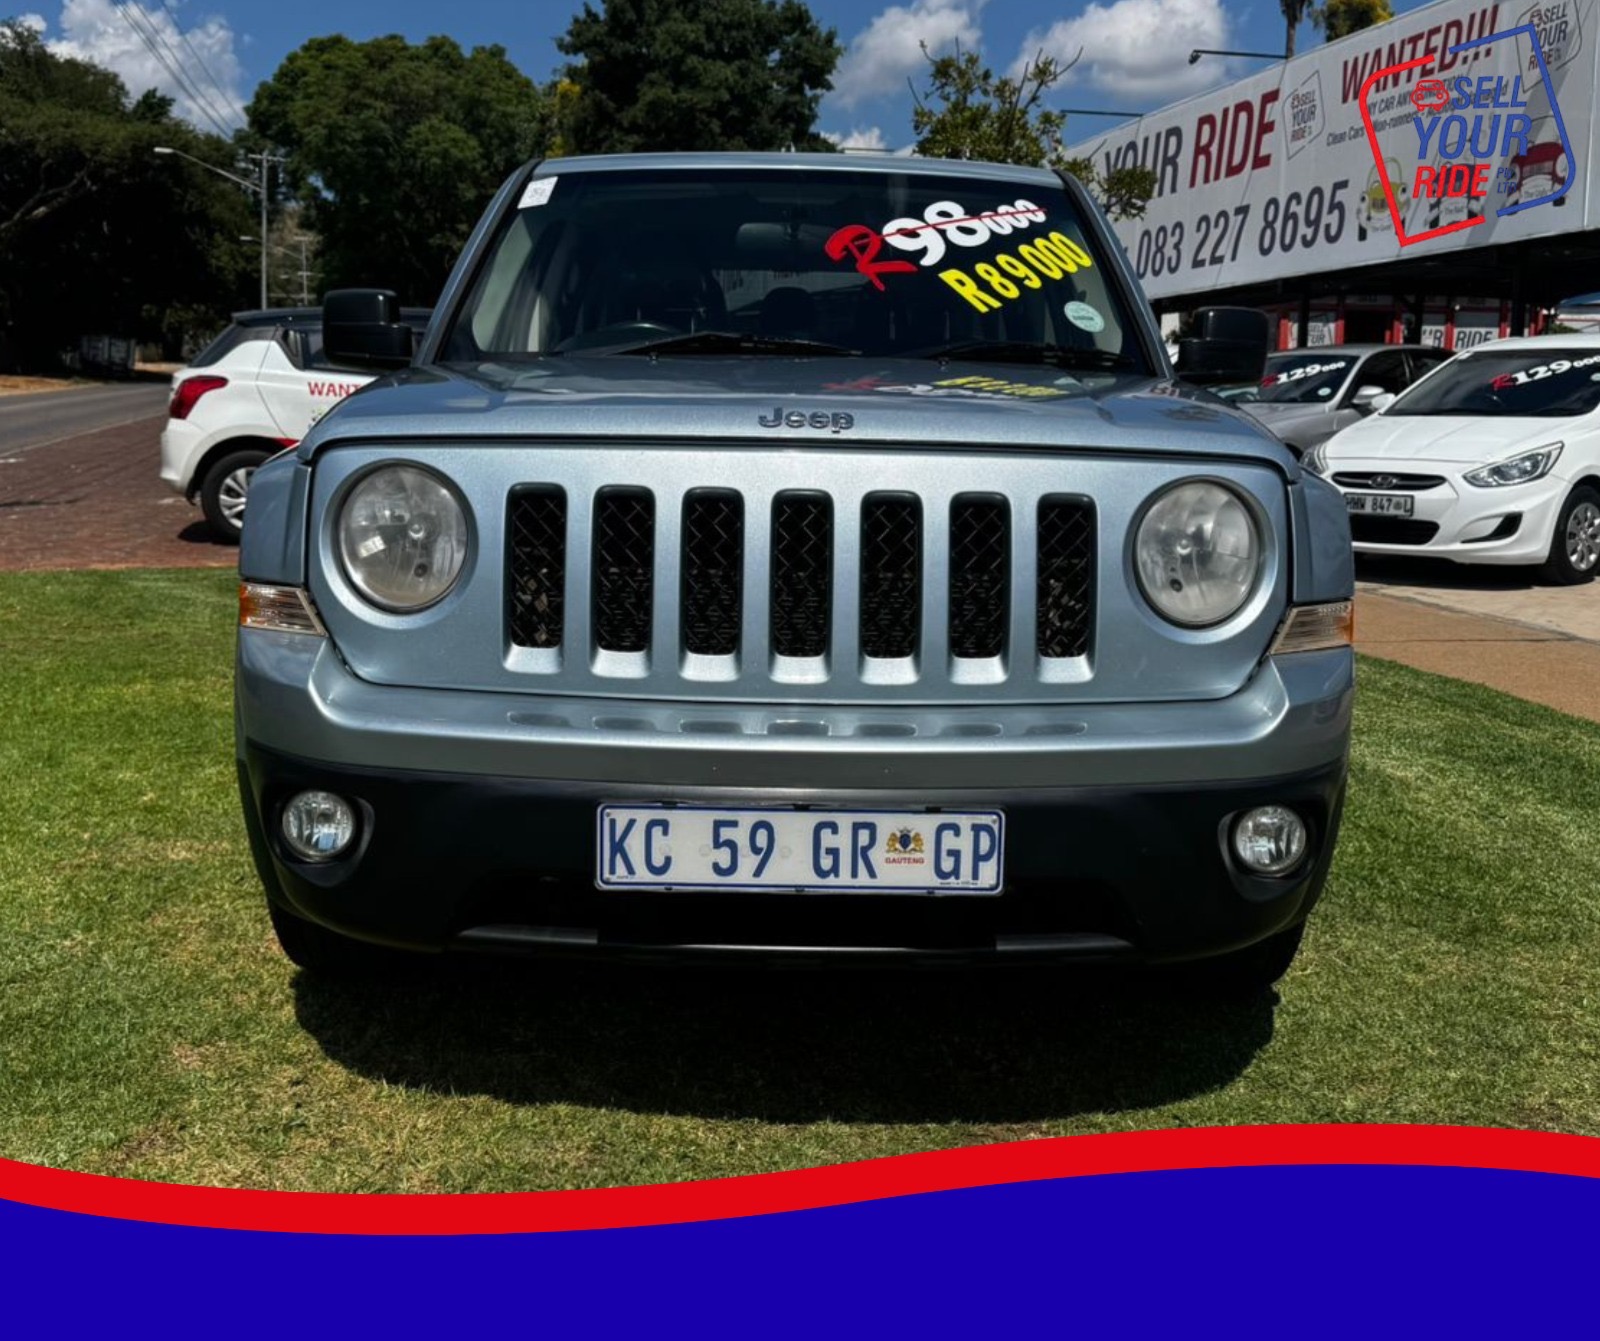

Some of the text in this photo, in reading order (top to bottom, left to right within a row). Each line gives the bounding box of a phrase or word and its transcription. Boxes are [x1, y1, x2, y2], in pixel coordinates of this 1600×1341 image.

[1530, 20, 1569, 52] OUR
[1542, 1, 1568, 25] SELL
[1342, 4, 1499, 104] WANTED!!!
[1189, 87, 1280, 188] RIDE
[1136, 179, 1350, 280] 083 227 8695
[758, 407, 855, 433] Jeep
[609, 818, 997, 882] KC 59 GR GP
[885, 857, 925, 865] GAUTENG
